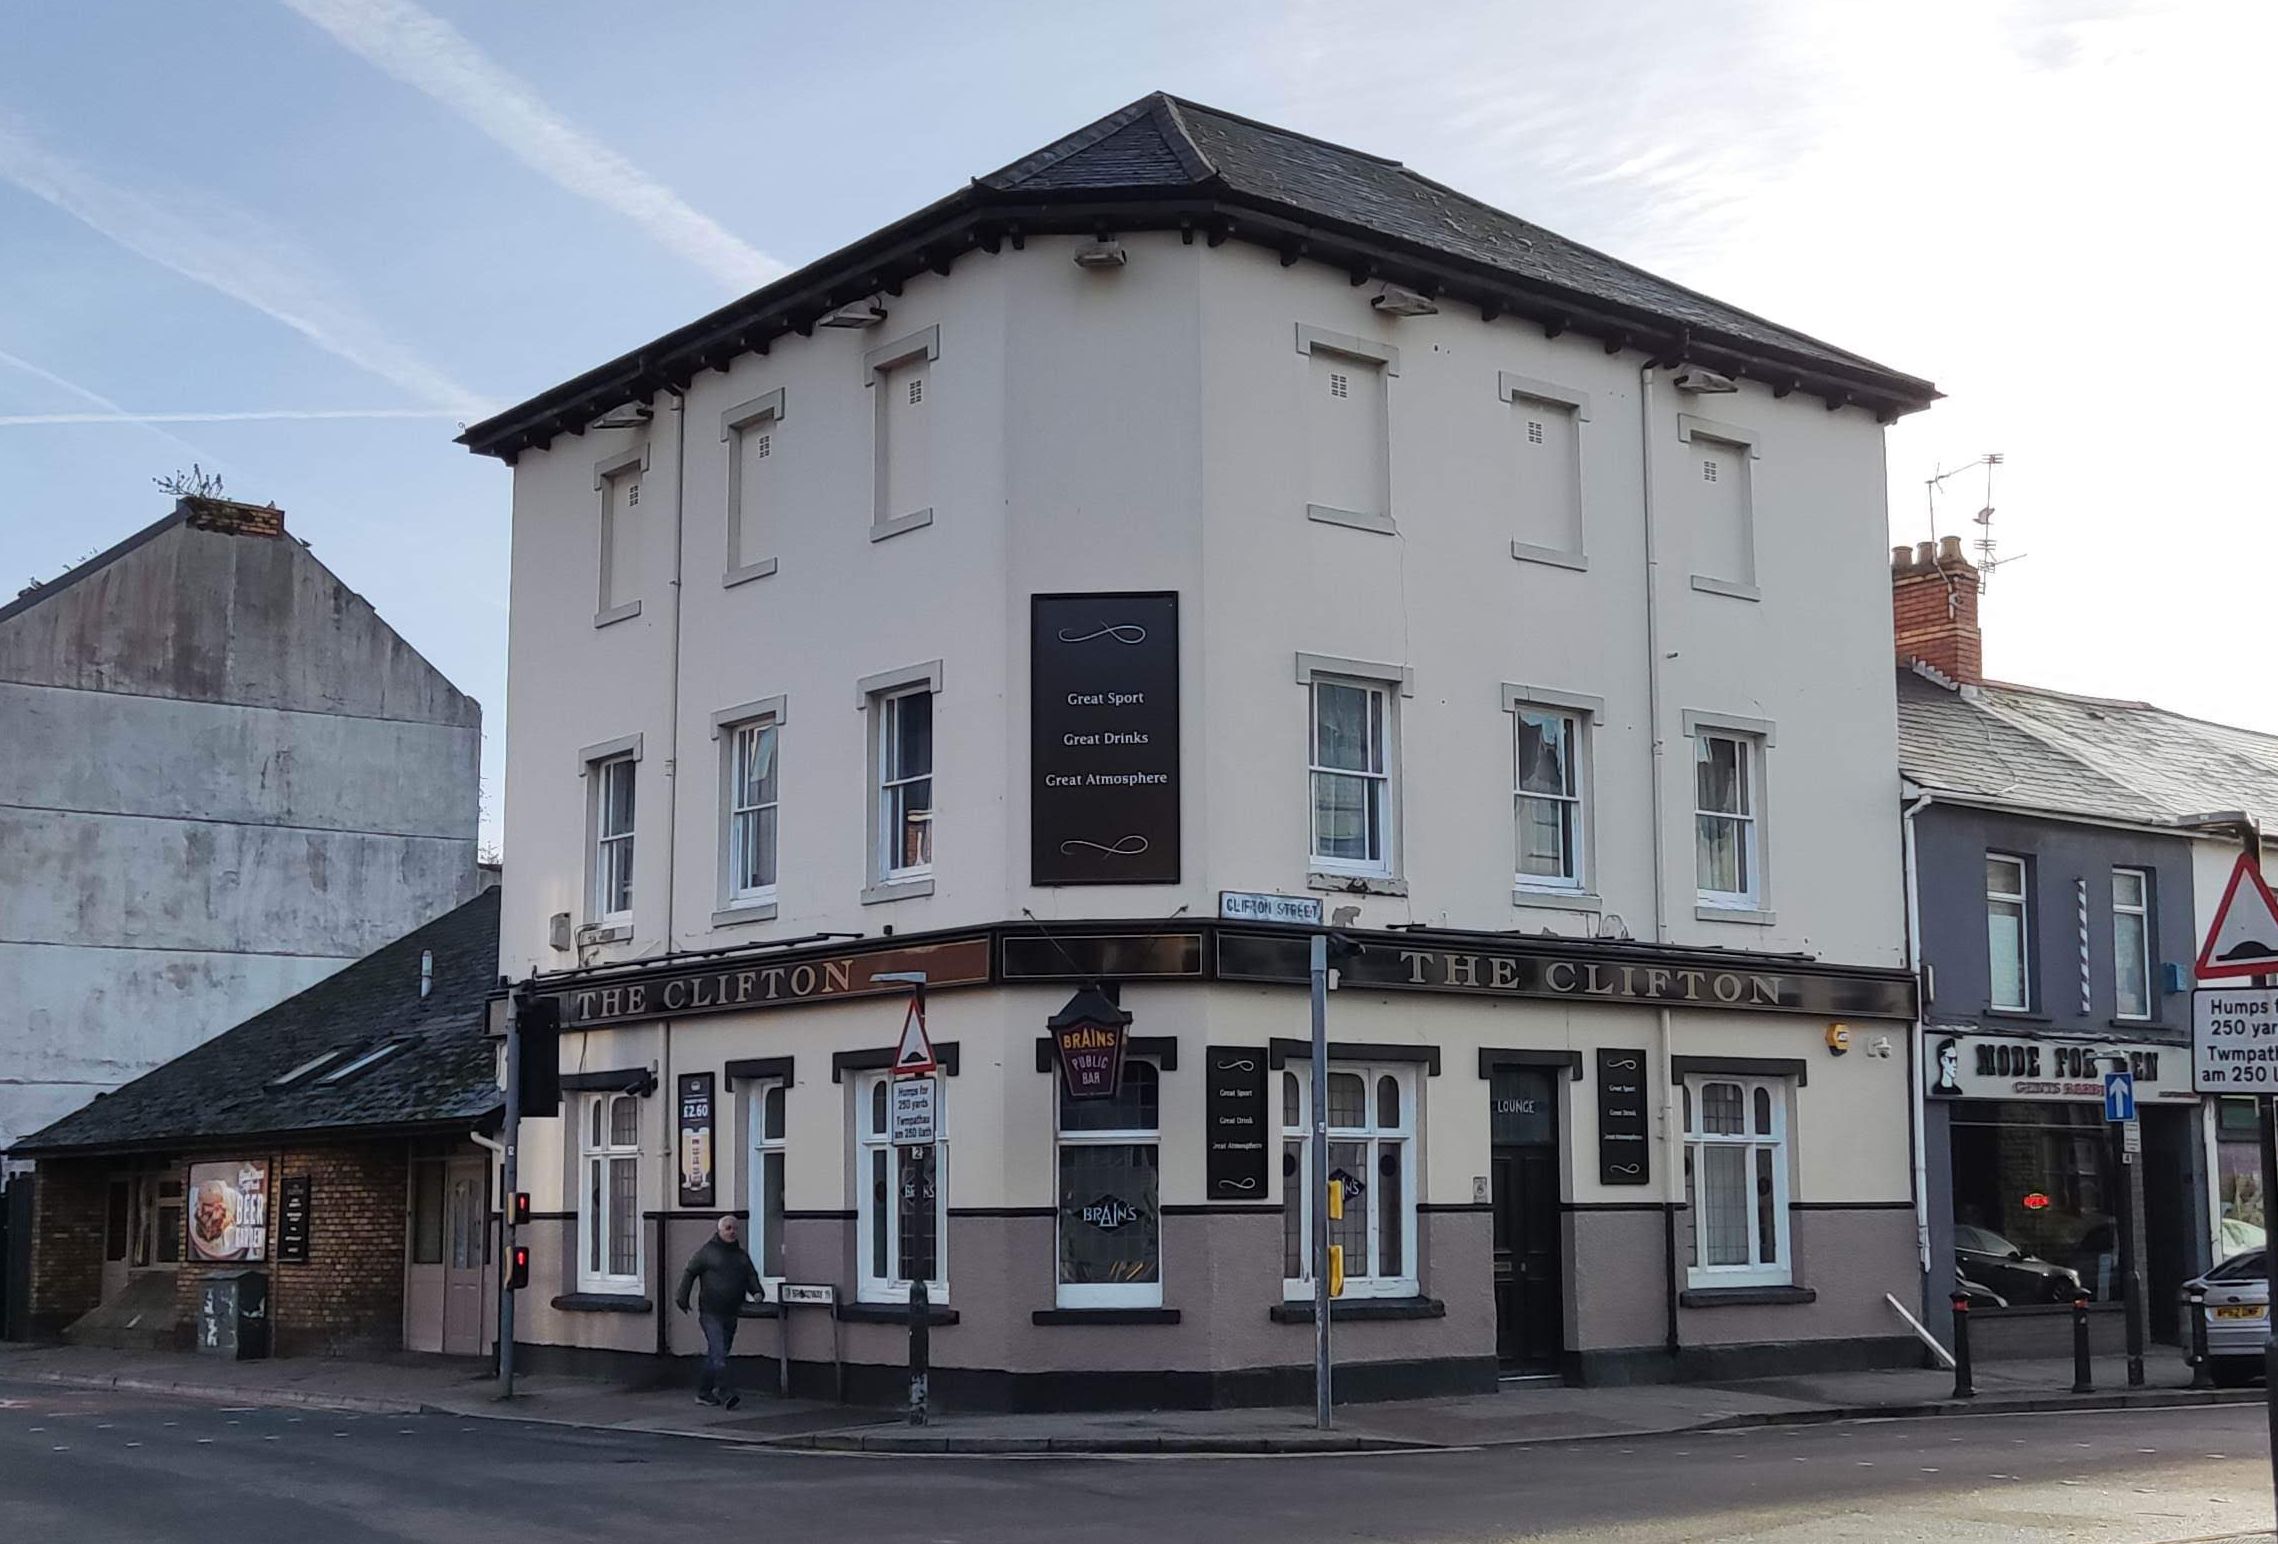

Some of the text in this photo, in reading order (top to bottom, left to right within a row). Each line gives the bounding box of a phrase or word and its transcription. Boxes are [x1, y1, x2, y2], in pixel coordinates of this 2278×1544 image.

[1067, 692, 1144, 706] Great Sport
[1063, 731, 1149, 746] Great Drinks
[1045, 772, 1168, 787] Great Atmosphere
[1226, 897, 1318, 919] CLIFTON STREET
[1400, 951, 1784, 1004] THE CLIFTON
[577, 960, 853, 1019] THE CLIFTON
[2210, 998, 2269, 1016] Humps
[2210, 1019, 2246, 1035] 250
[1063, 1027, 1116, 1049] BRAINS
[1071, 1055, 1109, 1071] PUBLIC
[1975, 1044, 2159, 1081] MODE FOR EN
[1082, 1072, 1101, 1085] BAR
[2201, 1070, 2226, 1082] am
[2231, 1066, 2267, 1082] 250
[898, 1098, 929, 1111] 250 yards
[1497, 1099, 1535, 1114] LOUNGE
[904, 1128, 917, 1138] 250
[913, 1148, 921, 1158] 2
[236, 1192, 264, 1225] BEER
